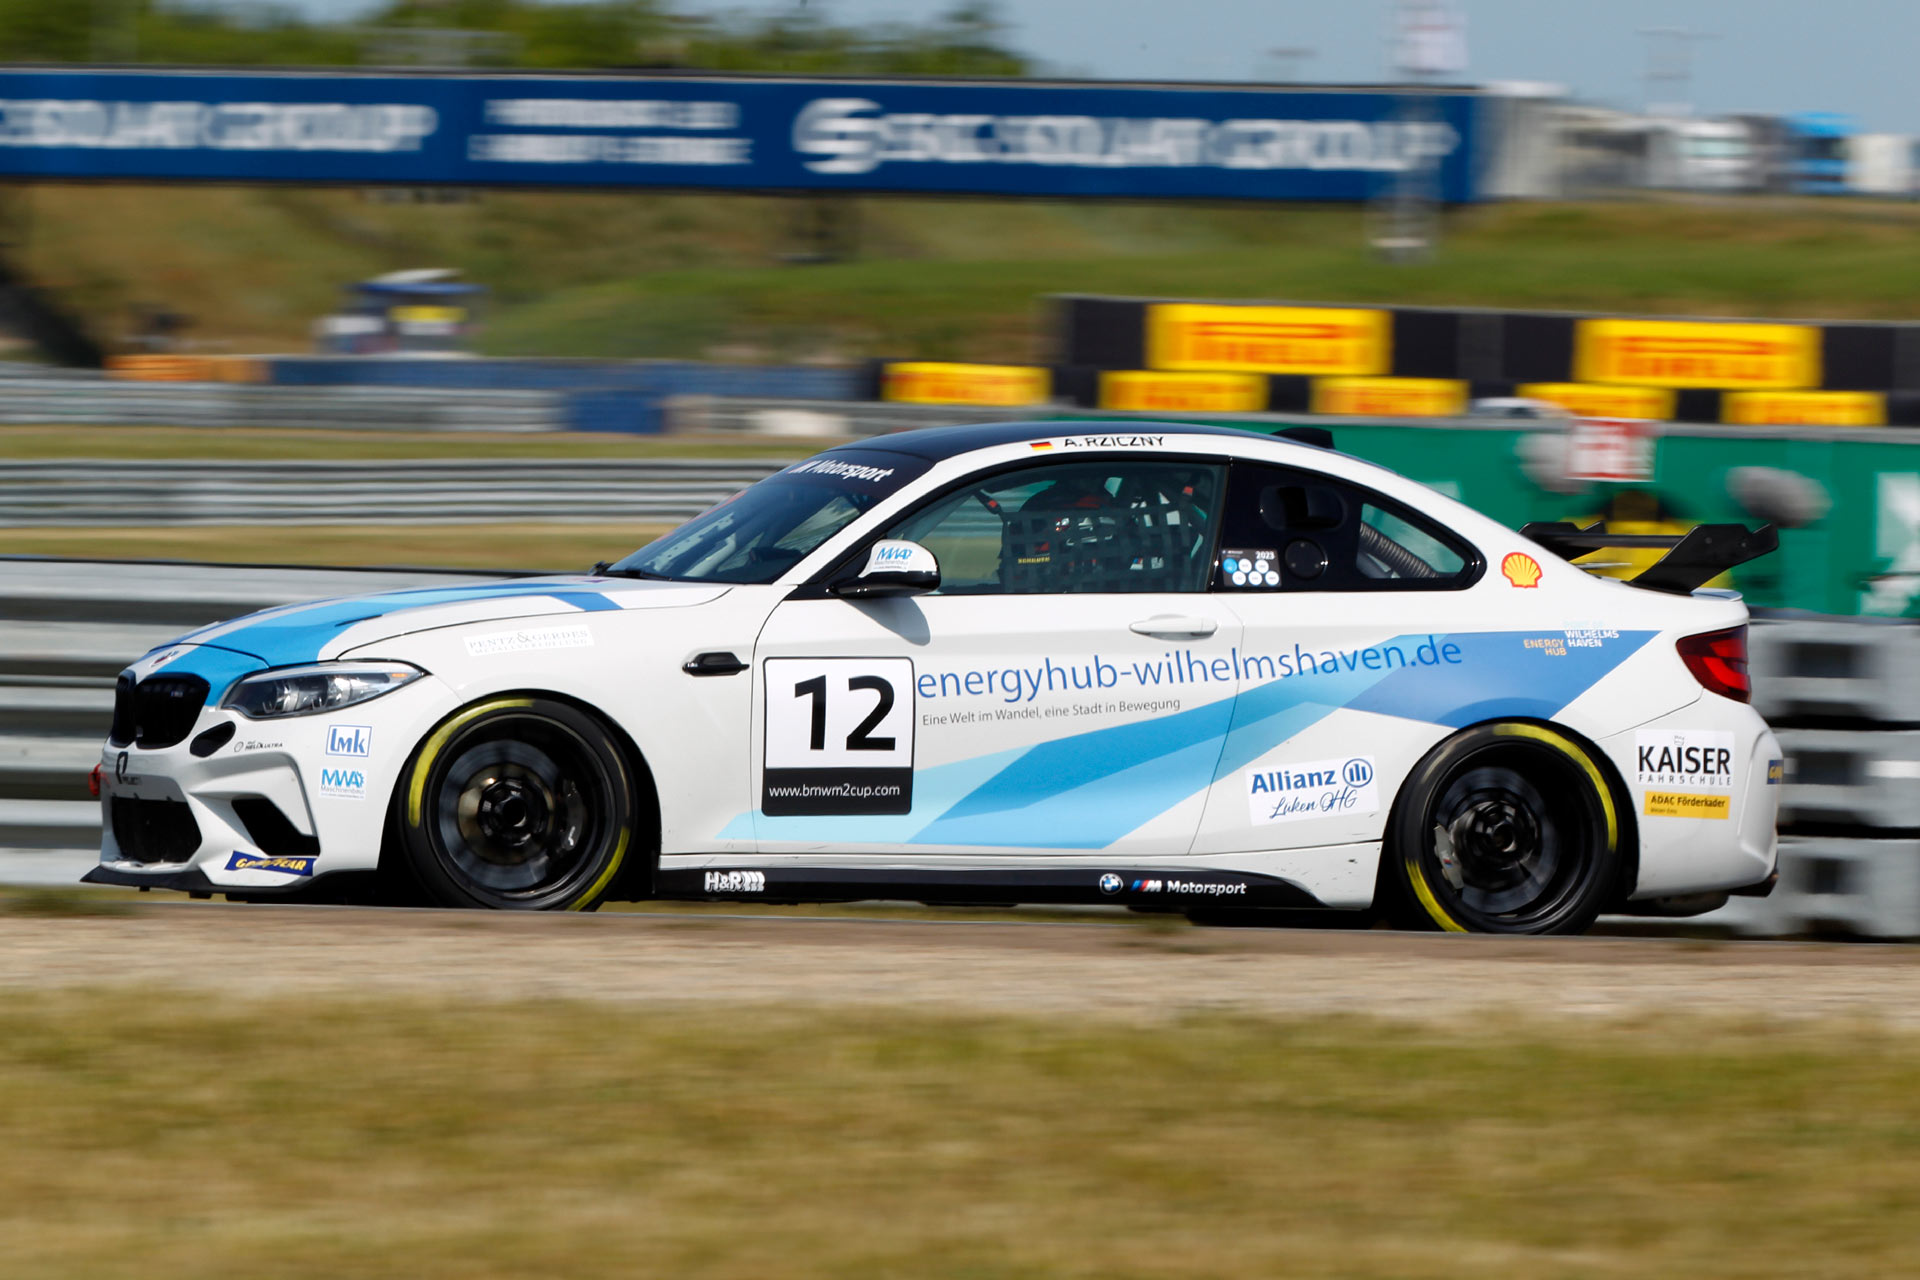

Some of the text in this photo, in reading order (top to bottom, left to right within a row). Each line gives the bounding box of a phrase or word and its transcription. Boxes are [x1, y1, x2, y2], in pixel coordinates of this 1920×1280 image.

[806, 460, 896, 482] Motorsport
[1255, 551, 1275, 560] 2023
[1564, 630, 1620, 639] WILHELMS
[1523, 639, 1564, 648] ENERGY
[1568, 639, 1602, 647] HAVEN
[1545, 648, 1567, 656] HUB
[917, 635, 1463, 703] energyhub-wilhelmshaven.de
[794, 674, 896, 751] 12
[922, 699, 1181, 726] Eine Welt im Wandel, eine Stadt in Bewegung
[1638, 745, 1731, 775] KAISER
[1251, 770, 1337, 794] Allianz
[1639, 774, 1732, 786] FAHRSCHULE
[769, 783, 900, 798] www.bmwm2cup.com
[1651, 794, 1726, 808] ADAC Förderkader
[1167, 879, 1247, 896] Motorsport
